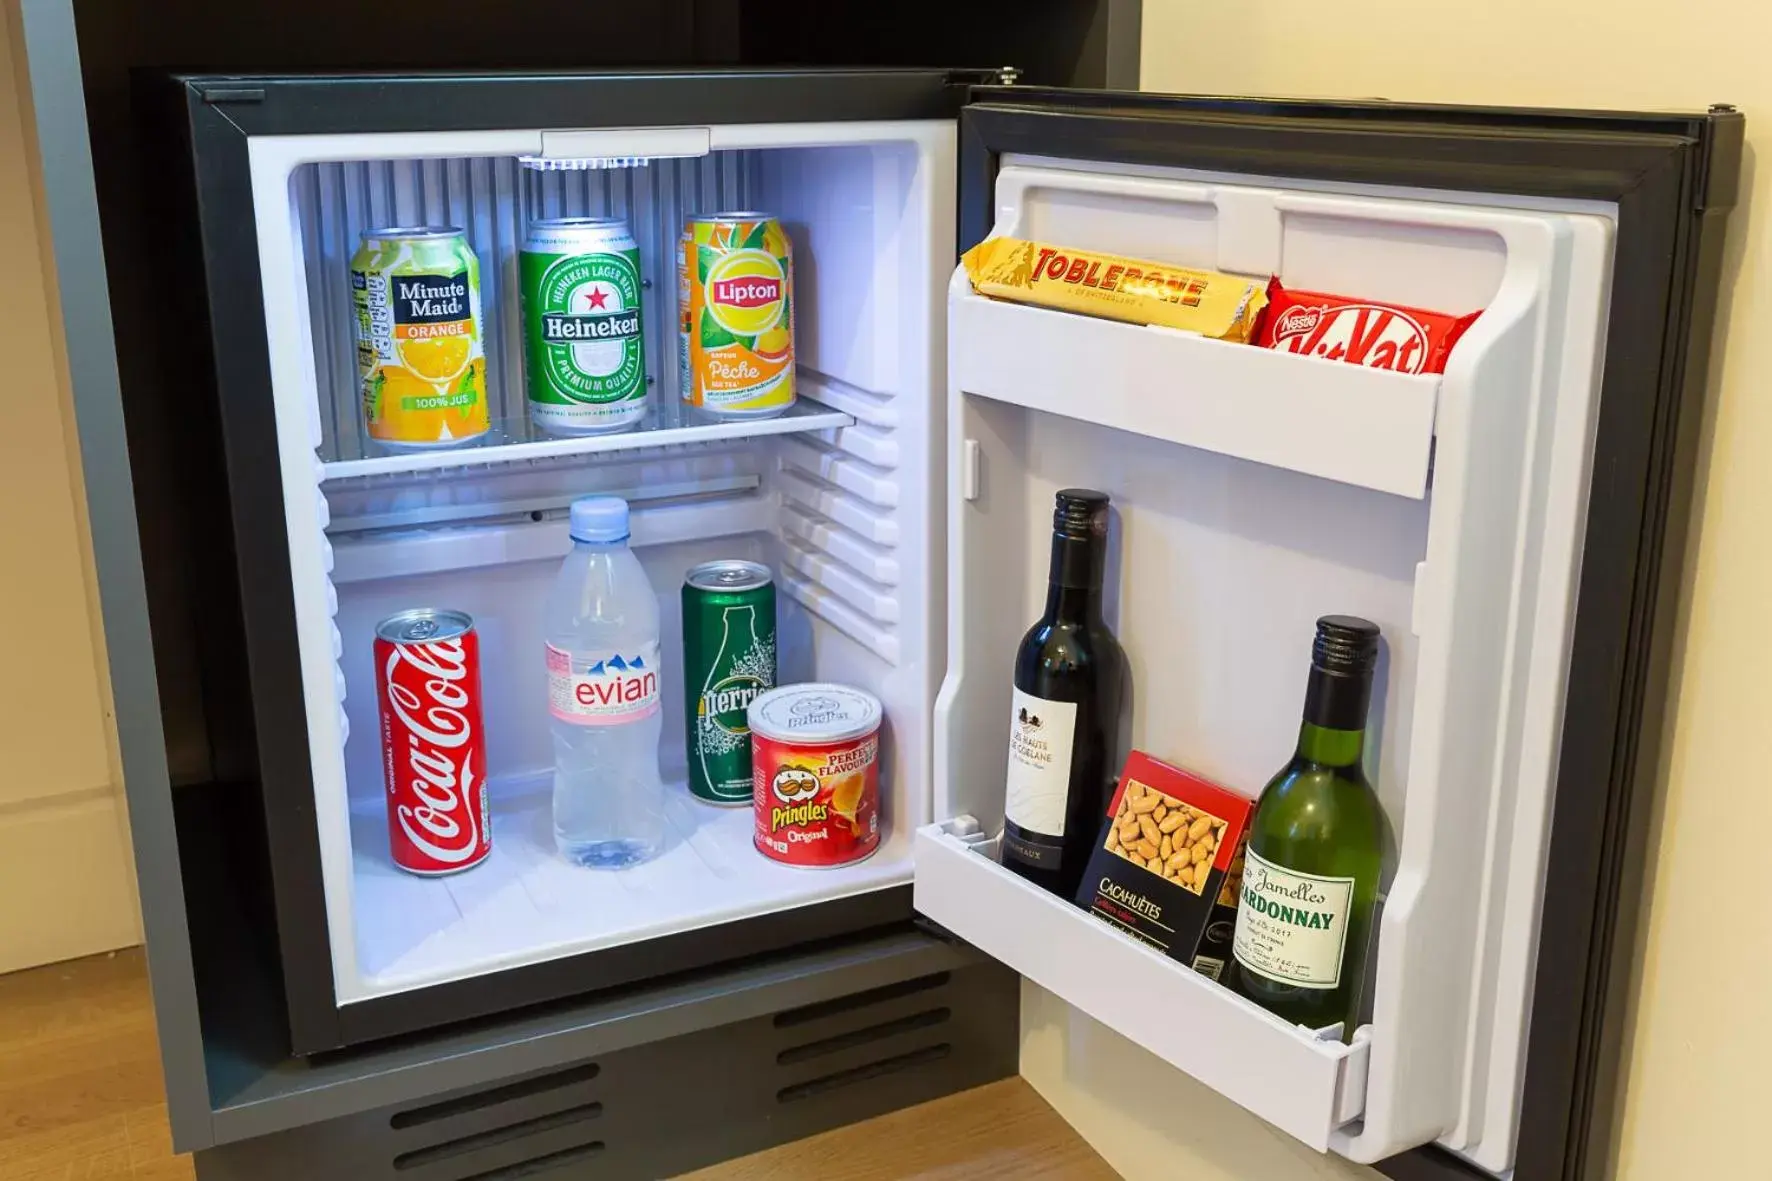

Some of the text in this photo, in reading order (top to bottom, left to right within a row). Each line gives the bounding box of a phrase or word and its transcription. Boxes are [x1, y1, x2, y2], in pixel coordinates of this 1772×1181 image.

[399, 282, 466, 300] Minute
[552, 265, 589, 304] HEINEKEN
[591, 265, 621, 280] LAGER
[719, 283, 778, 303] Lipton
[1031, 247, 1209, 307] TOBLERONE
[410, 299, 459, 317] Maid
[407, 323, 465, 338] ORANGE
[546, 316, 639, 338] Heineken
[1286, 307, 1422, 375] KKat
[558, 354, 636, 391] PREMIUM QUALITY
[708, 360, 760, 379] Pêche
[416, 394, 469, 409] 100% JUS
[575, 671, 657, 705] evian
[703, 681, 766, 732] perri
[383, 711, 396, 794] ORIGINAL TASTE
[829, 741, 873, 766] PERFE
[772, 801, 828, 832] Pringles
[787, 828, 829, 844] Original
[1098, 876, 1163, 921] CACAHUÈTES
[1253, 868, 1326, 904] Jamelles
[1240, 881, 1335, 931] ARDONNAY
